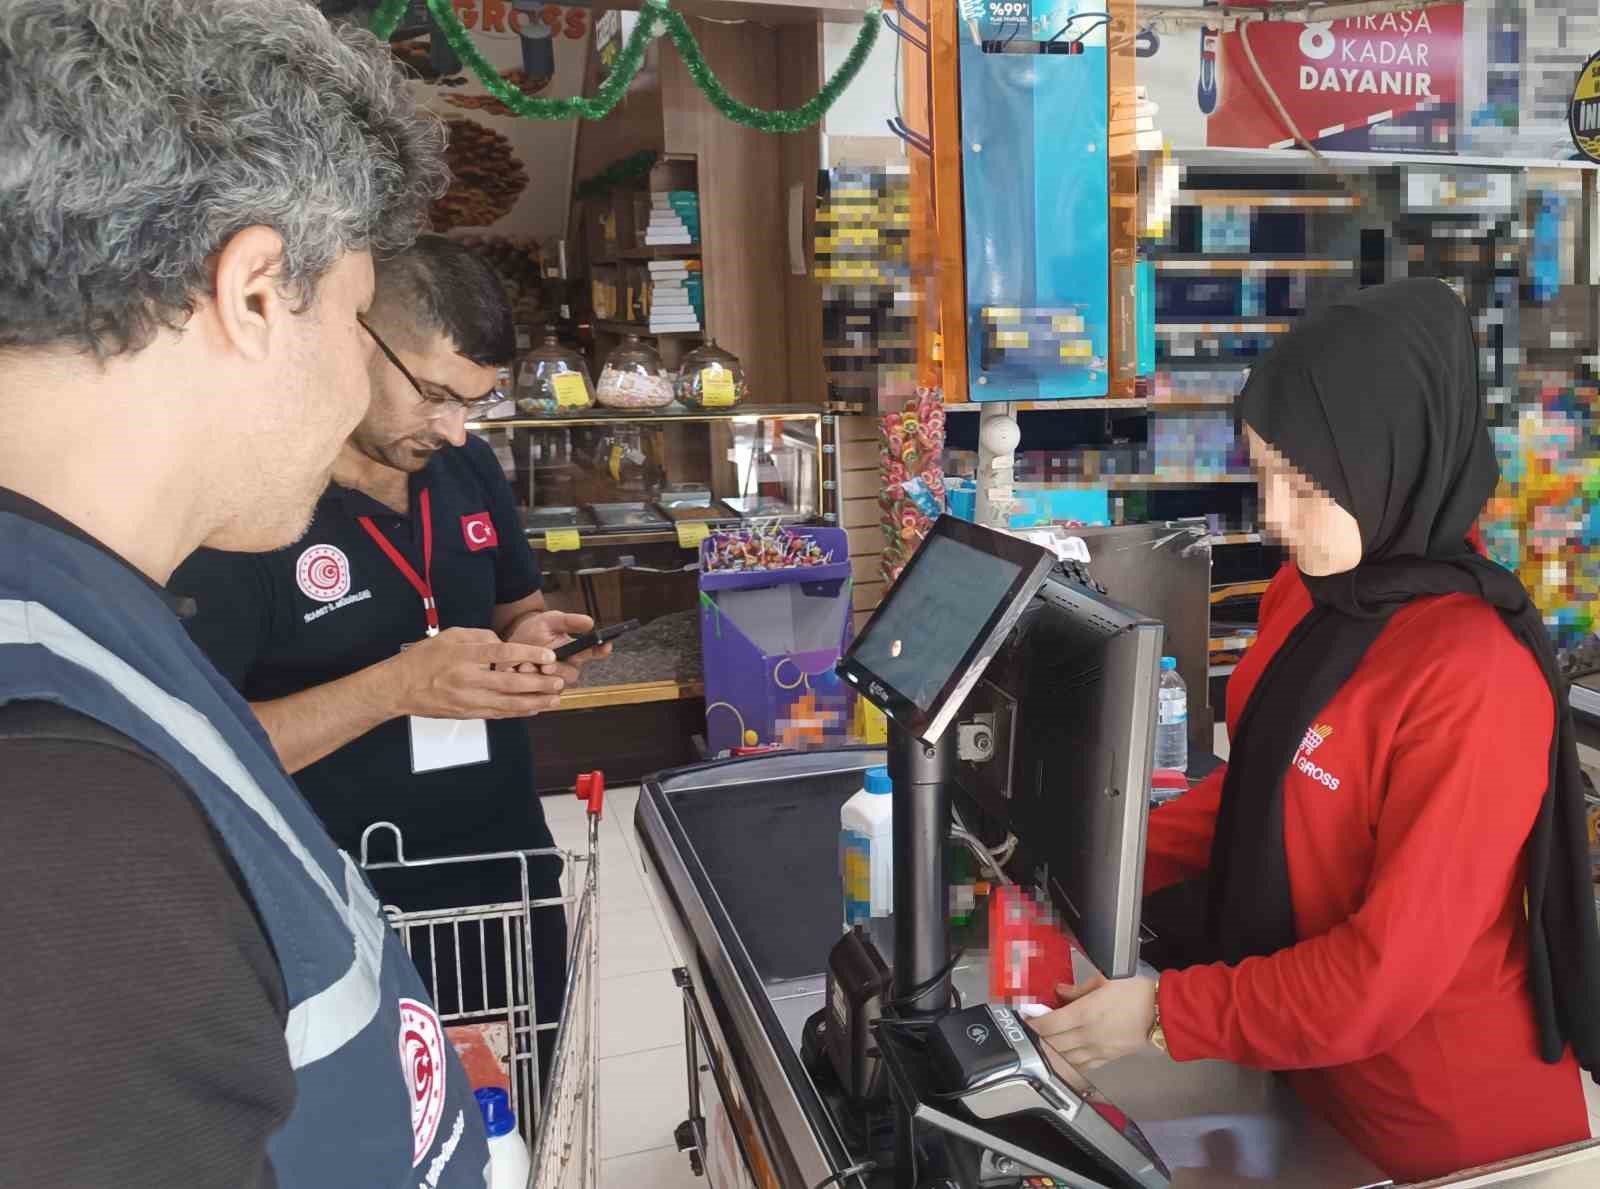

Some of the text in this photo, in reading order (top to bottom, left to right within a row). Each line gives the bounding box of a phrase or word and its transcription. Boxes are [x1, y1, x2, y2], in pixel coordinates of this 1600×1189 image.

[1341, 38, 1429, 67] KADAR
[1300, 65, 1432, 97] DAYANIR
[1297, 756, 1340, 790] GROSS
